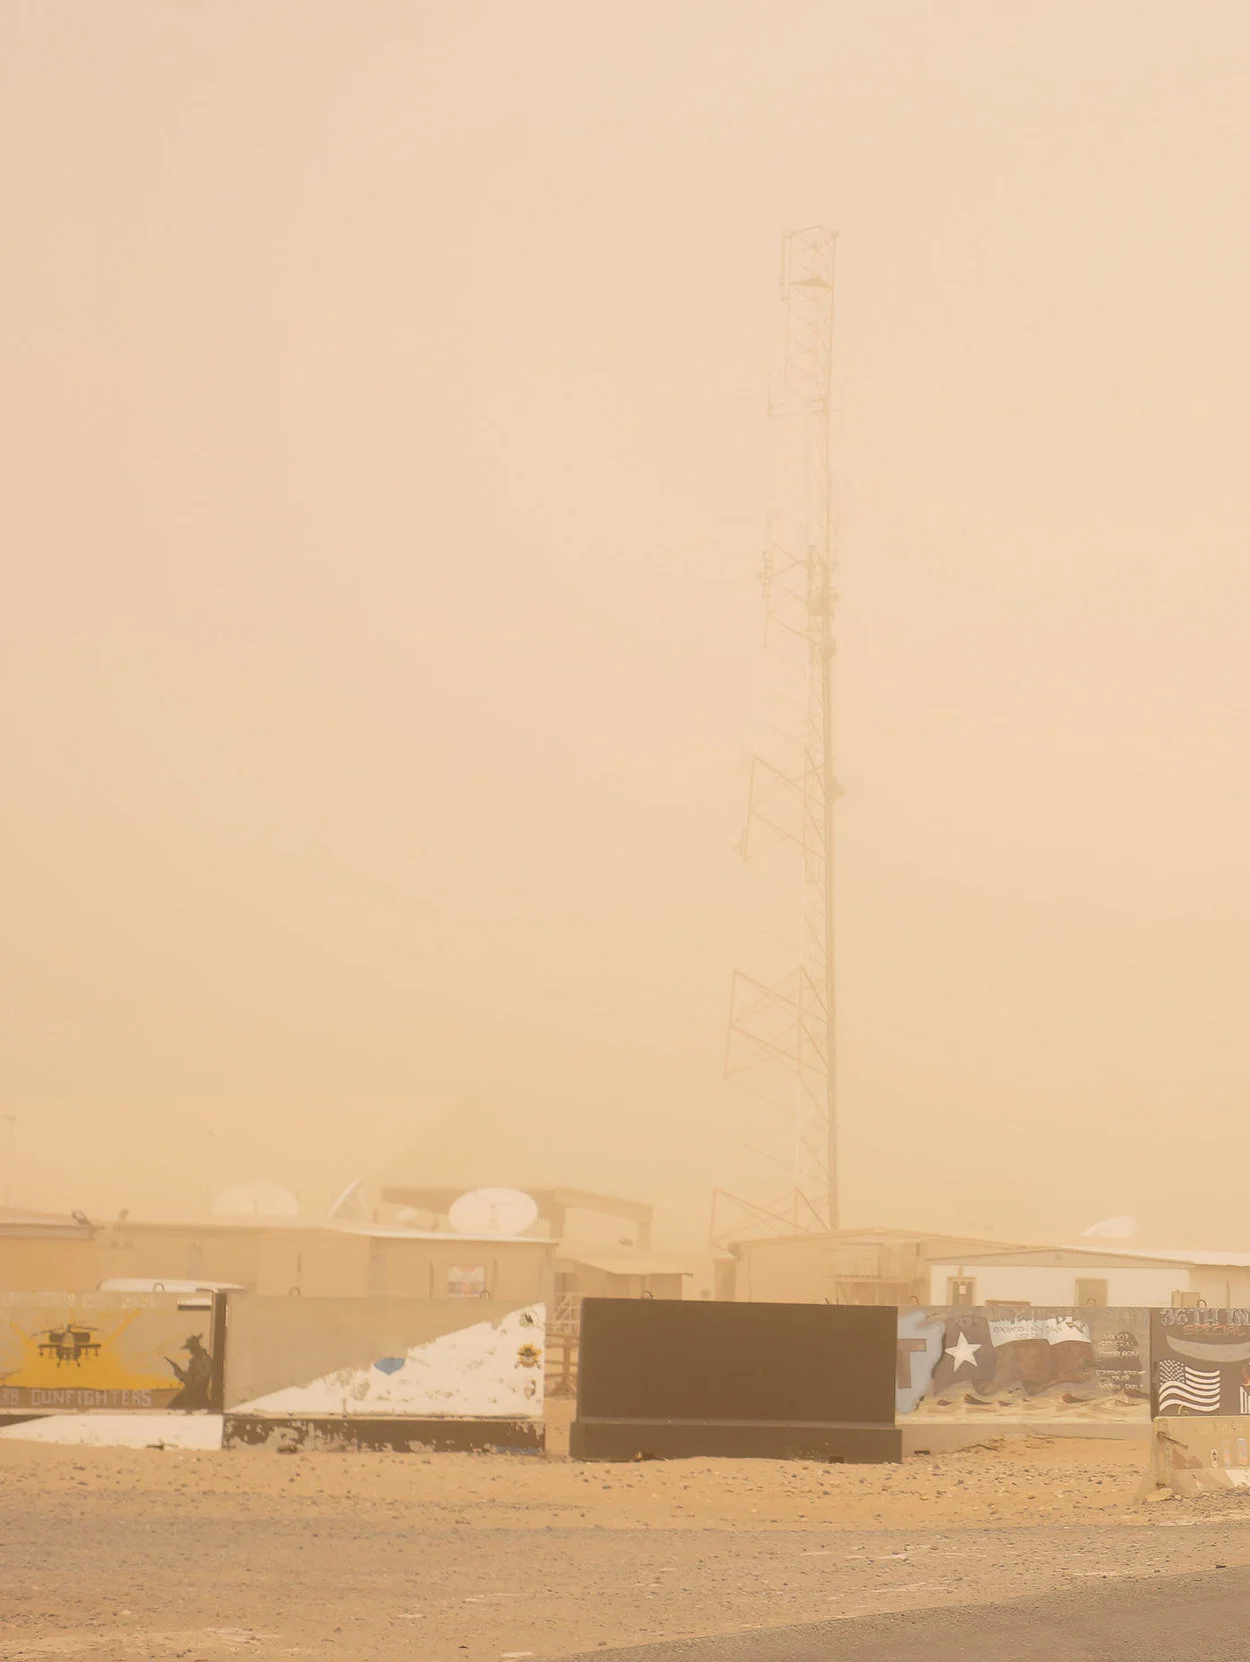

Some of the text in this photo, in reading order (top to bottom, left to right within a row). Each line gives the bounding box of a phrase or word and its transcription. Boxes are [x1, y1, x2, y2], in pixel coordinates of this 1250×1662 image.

[1160, 1309, 1219, 1326] 36TH
[1183, 1325, 1246, 1336] SPECIAL
[31, 1388, 152, 1407] GUNFIGHTERS
